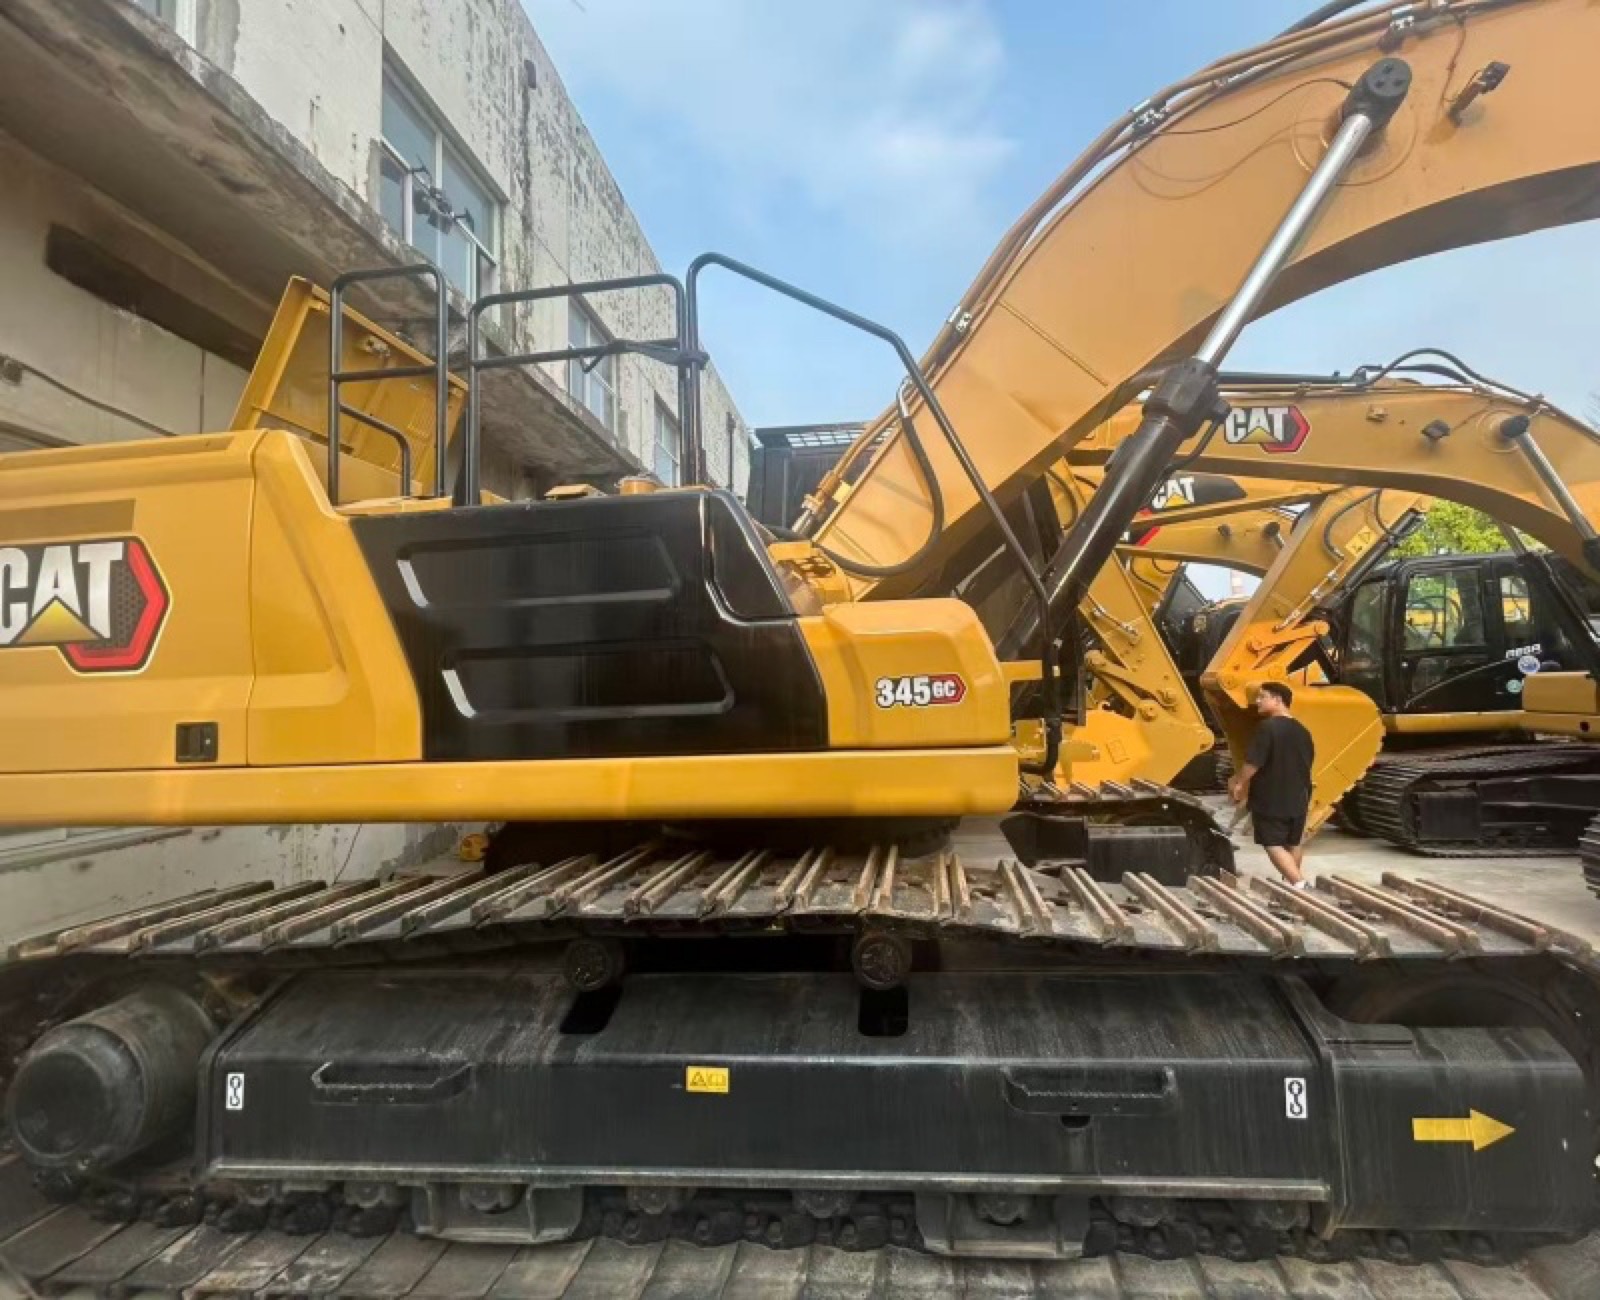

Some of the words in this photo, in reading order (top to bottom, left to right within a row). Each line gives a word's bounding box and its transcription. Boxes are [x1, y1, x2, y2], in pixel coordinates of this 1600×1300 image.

[1225, 407, 1288, 442] CAT
[0, 541, 124, 644] CAT
[877, 677, 930, 706] 345
[932, 680, 956, 698] GC
